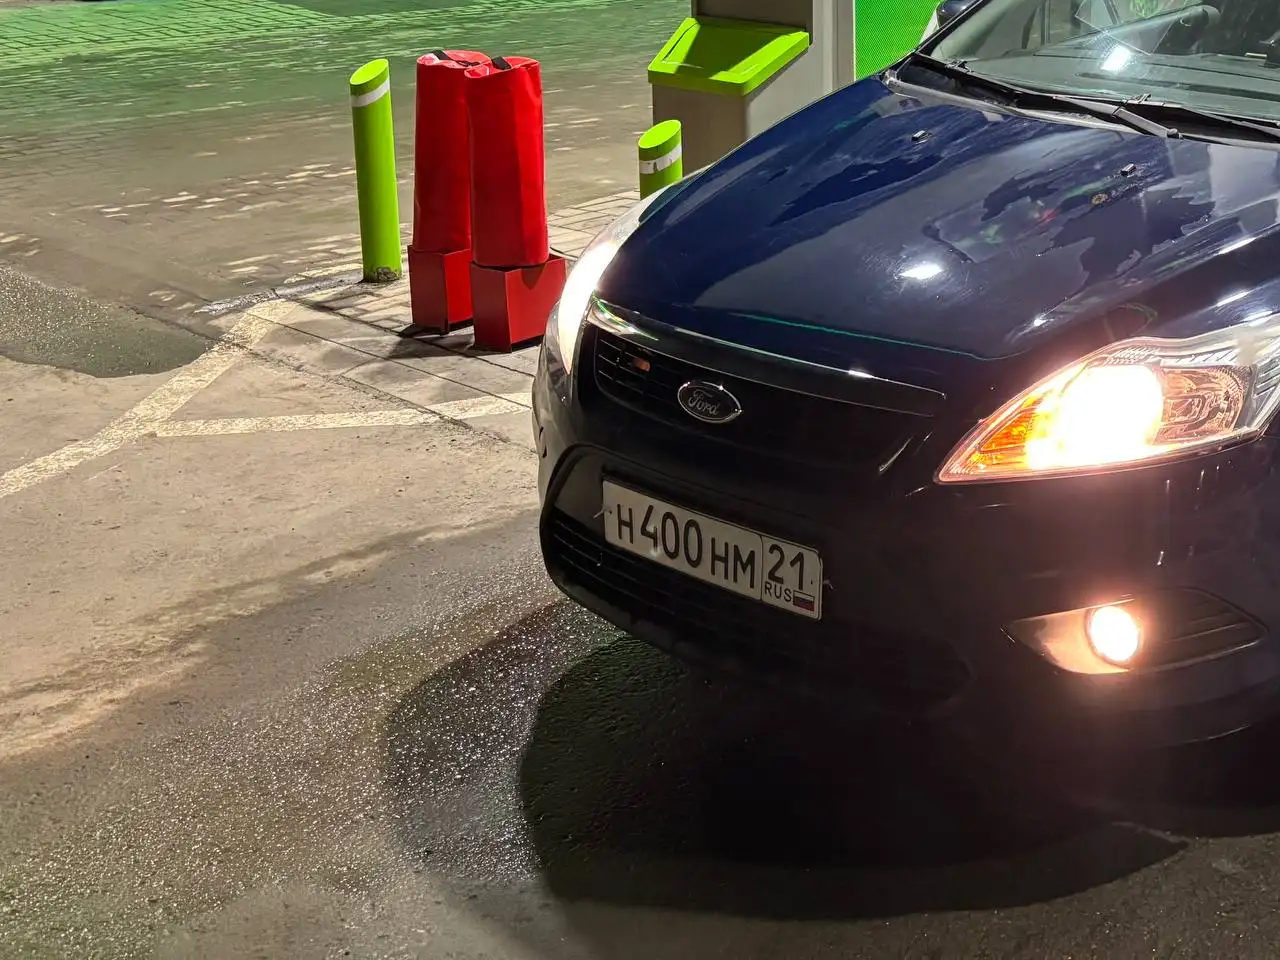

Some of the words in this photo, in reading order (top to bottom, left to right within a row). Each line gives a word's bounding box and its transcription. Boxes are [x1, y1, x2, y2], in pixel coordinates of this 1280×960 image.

[688, 388, 721, 416] Ford
[767, 543, 805, 590] 21
[764, 580, 792, 603] RUS
